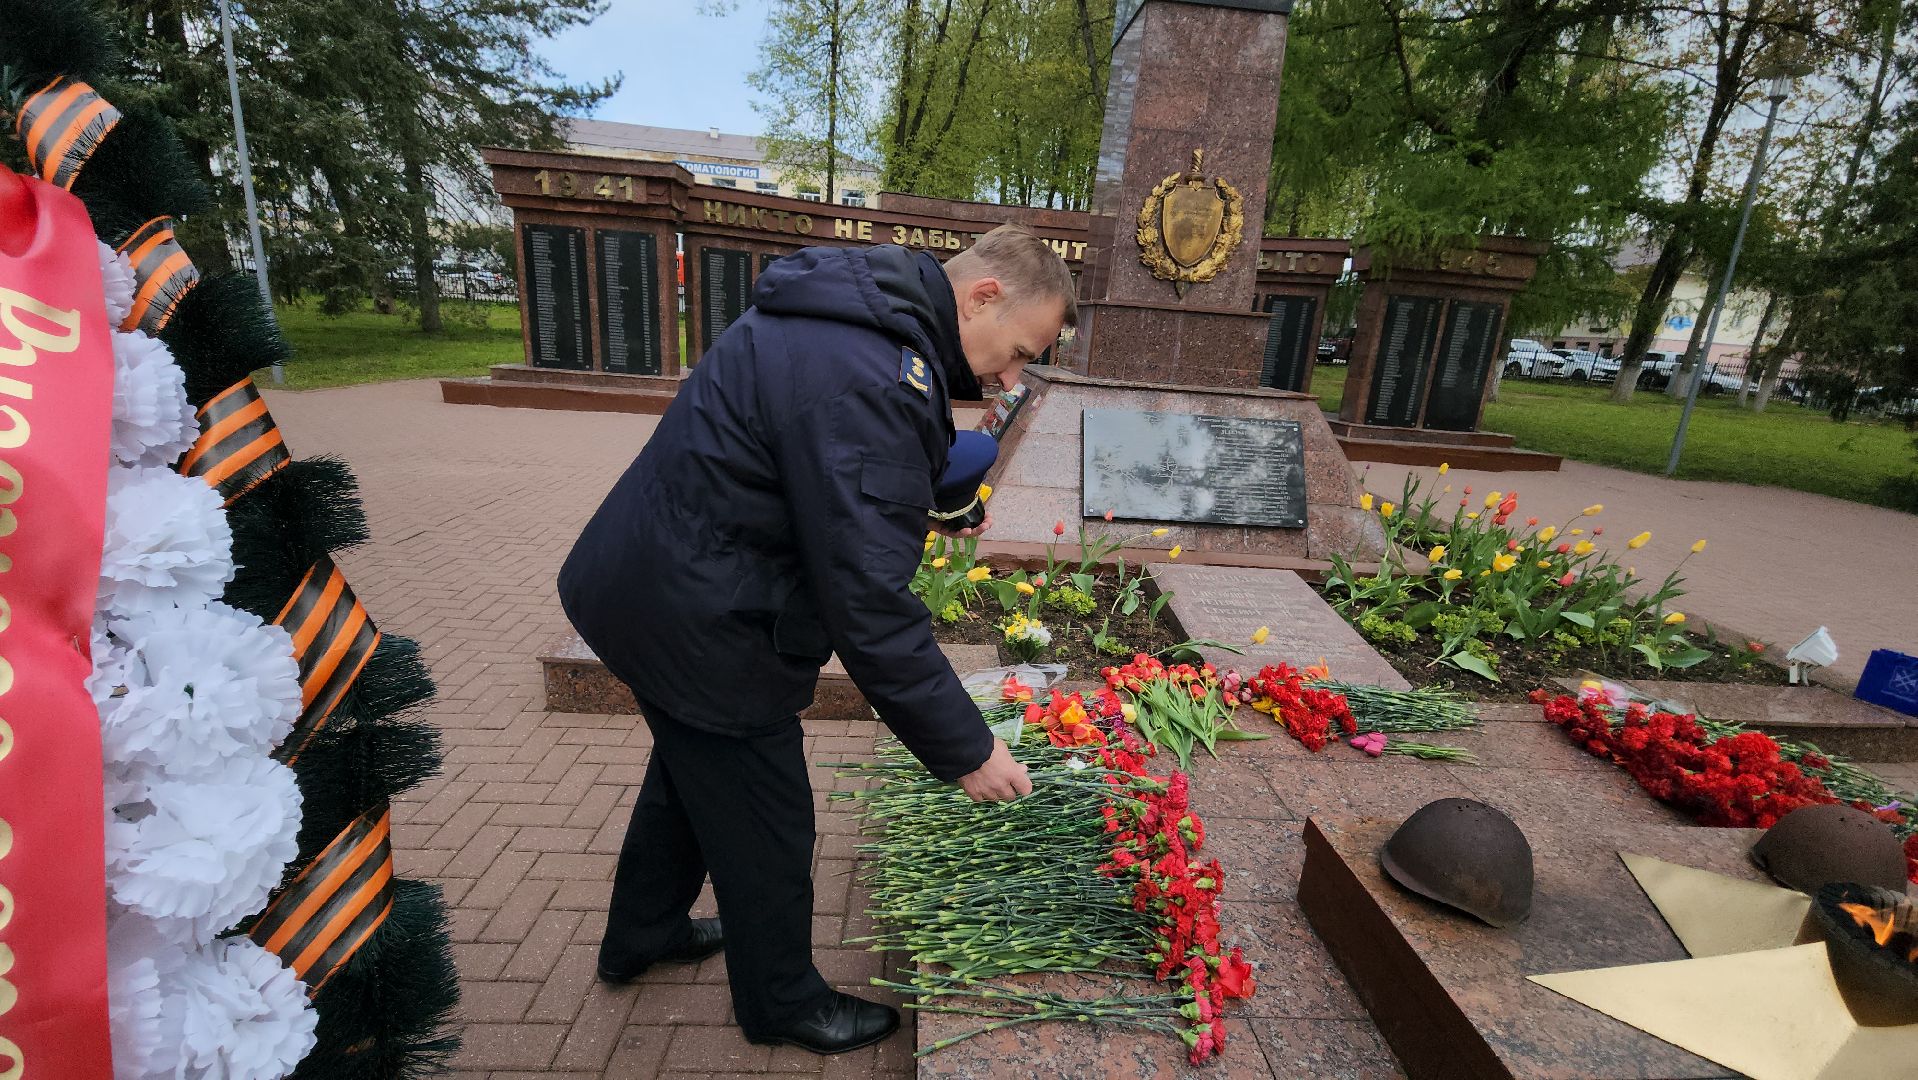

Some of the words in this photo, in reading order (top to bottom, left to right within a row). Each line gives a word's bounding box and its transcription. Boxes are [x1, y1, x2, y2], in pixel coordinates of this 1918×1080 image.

[534, 169, 634, 201] 1941
[677, 162, 757, 178] ТОМАТОЛОГИЯ
[703, 199, 813, 235] НИКТО
[834, 218, 873, 241] НЕ
